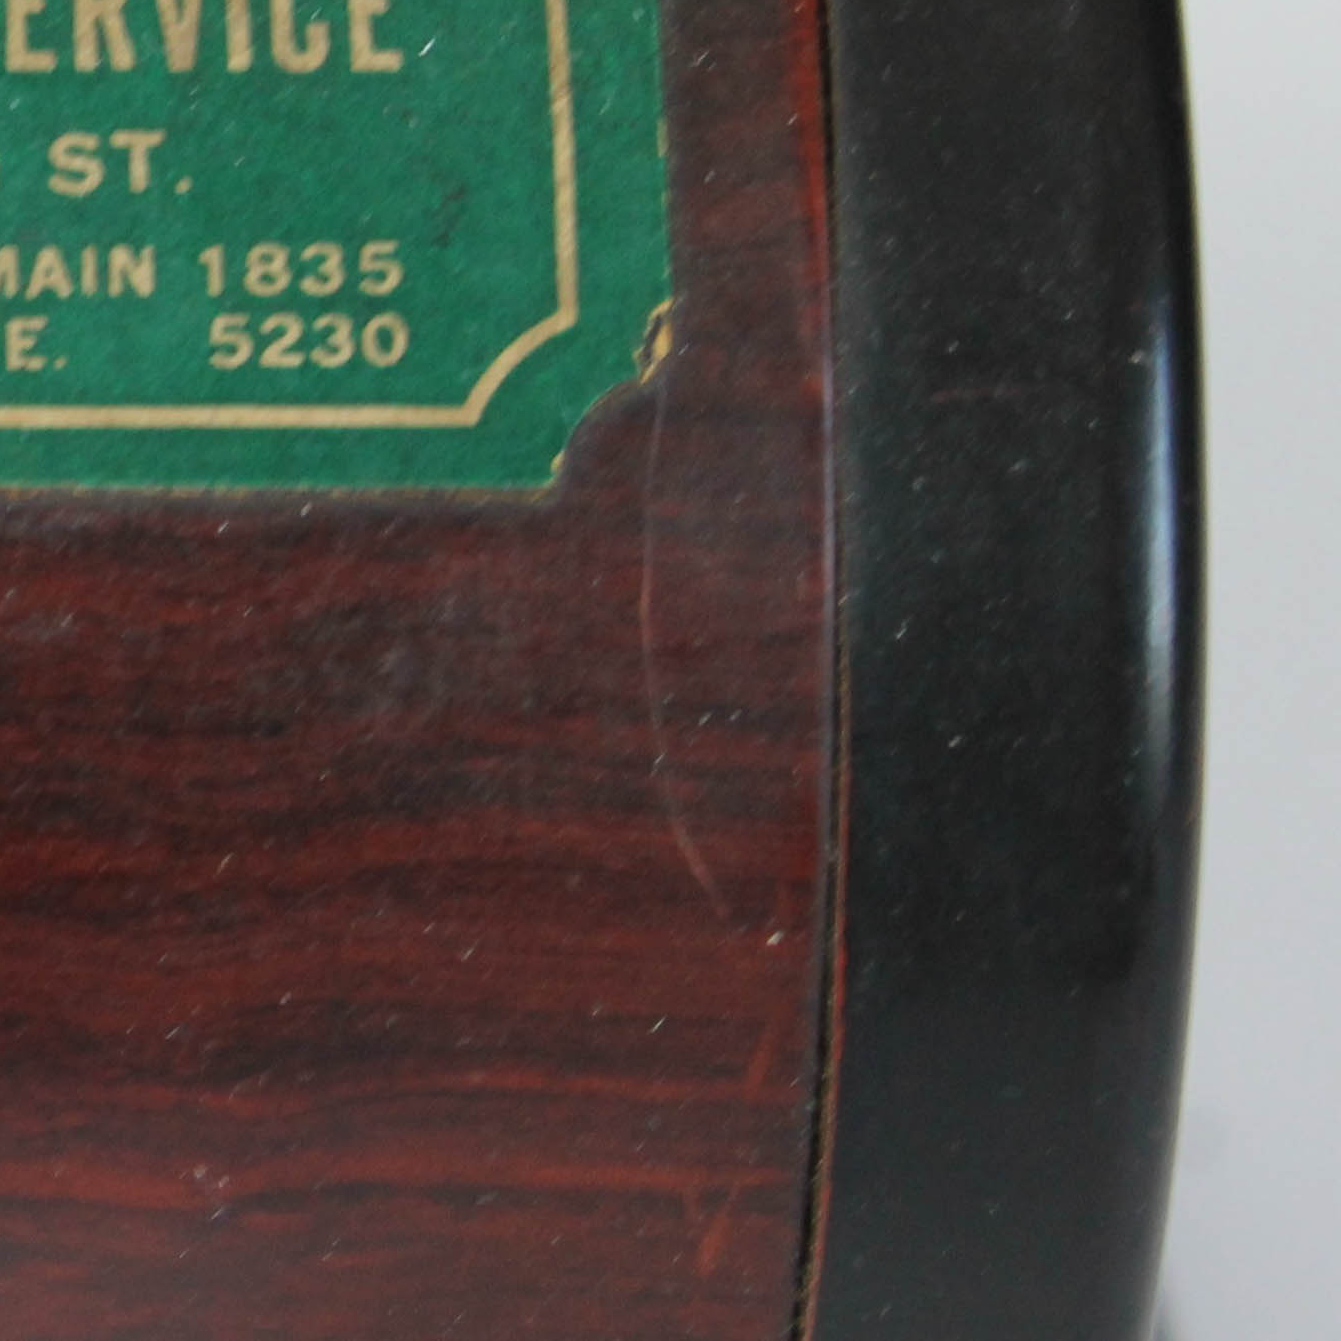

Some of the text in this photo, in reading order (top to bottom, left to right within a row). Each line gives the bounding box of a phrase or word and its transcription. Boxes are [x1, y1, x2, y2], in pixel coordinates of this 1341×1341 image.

[47, 131, 192, 197] ST.
[198, 241, 405, 297] 1835
[208, 313, 410, 370] 5230
